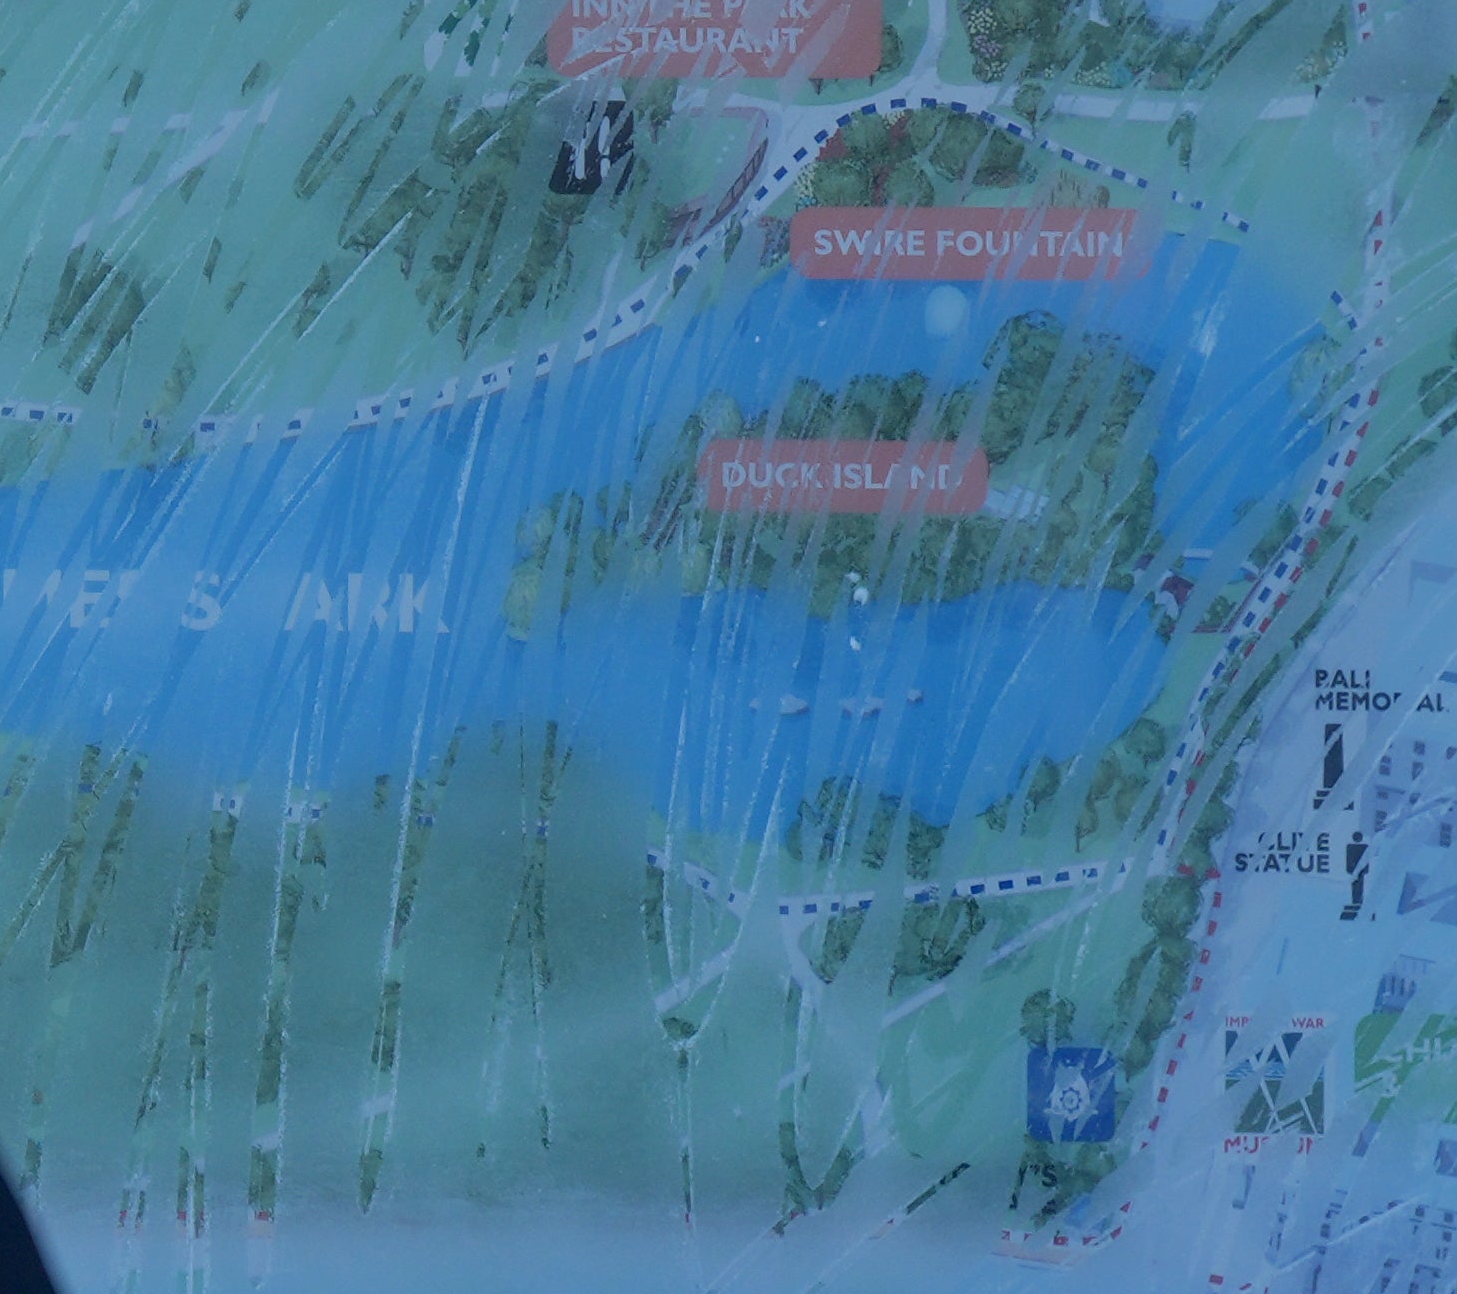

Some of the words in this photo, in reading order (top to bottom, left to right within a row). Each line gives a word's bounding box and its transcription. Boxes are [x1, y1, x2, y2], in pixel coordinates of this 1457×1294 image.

[814, 229, 925, 256] SWRE
[722, 462, 824, 488] DUCK
[284, 572, 450, 633] ARK
[1315, 669, 1371, 689] BALI
[1315, 692, 1450, 713] MEMOAL
[1292, 1017, 1325, 1029] WAR
